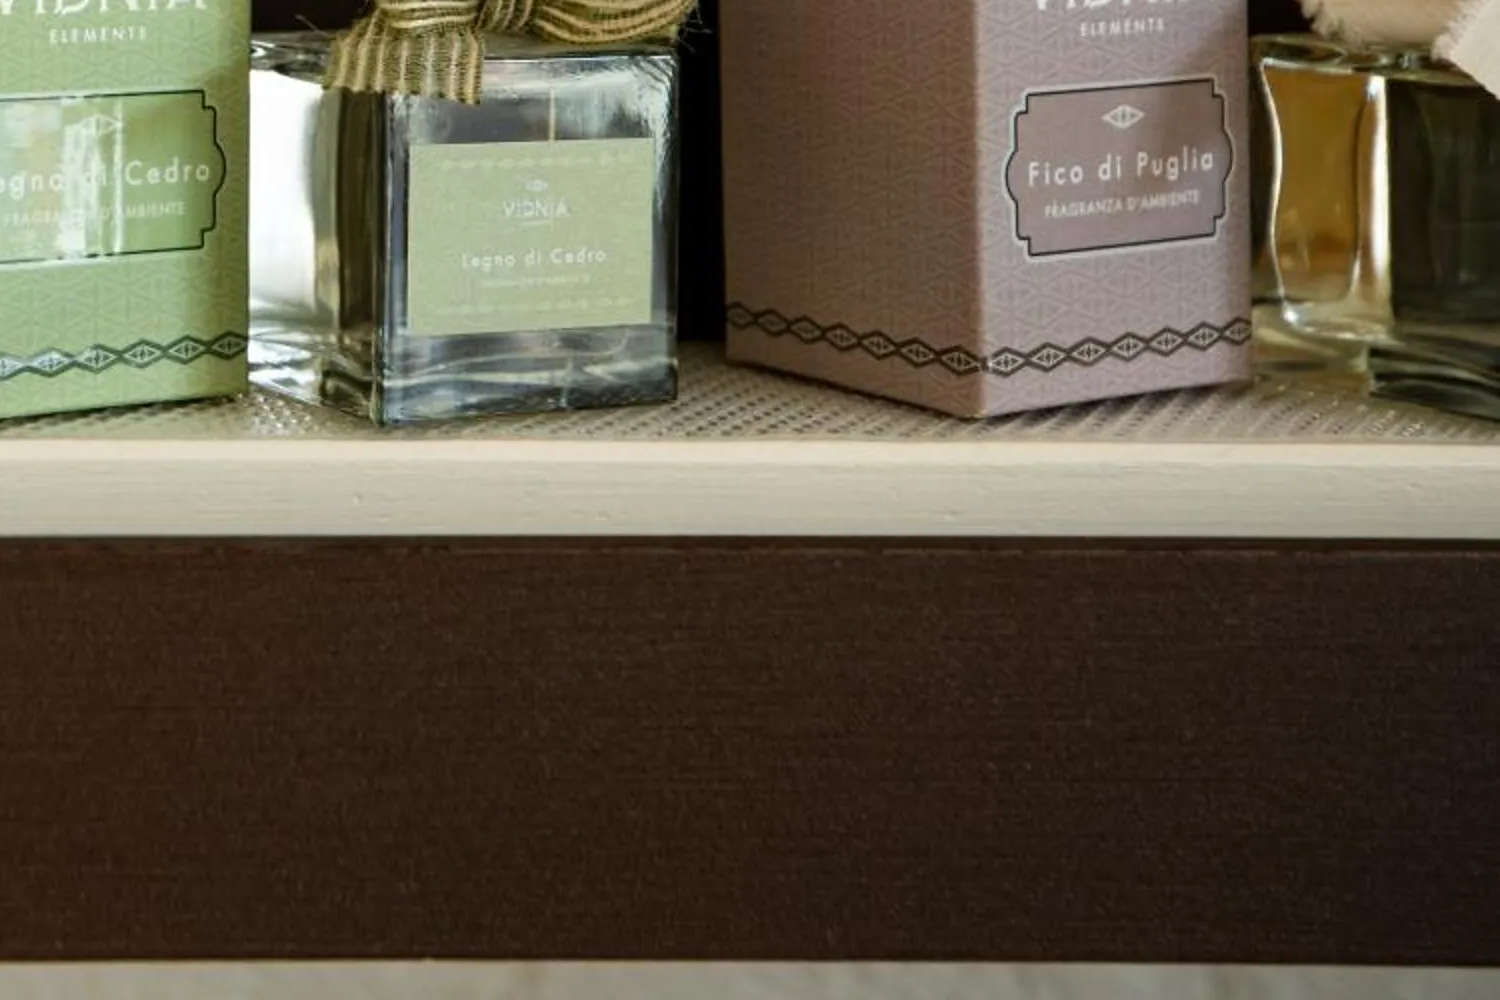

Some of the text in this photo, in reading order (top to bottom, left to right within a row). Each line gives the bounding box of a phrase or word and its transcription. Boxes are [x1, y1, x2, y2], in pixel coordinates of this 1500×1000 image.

[49, 25, 148, 45] ELEMENTS
[1079, 17, 1166, 37] ELEMENTS
[125, 157, 210, 186] Cedro
[1027, 144, 1215, 187] Fico di Puglia
[462, 245, 606, 272] Legno di Cedro
